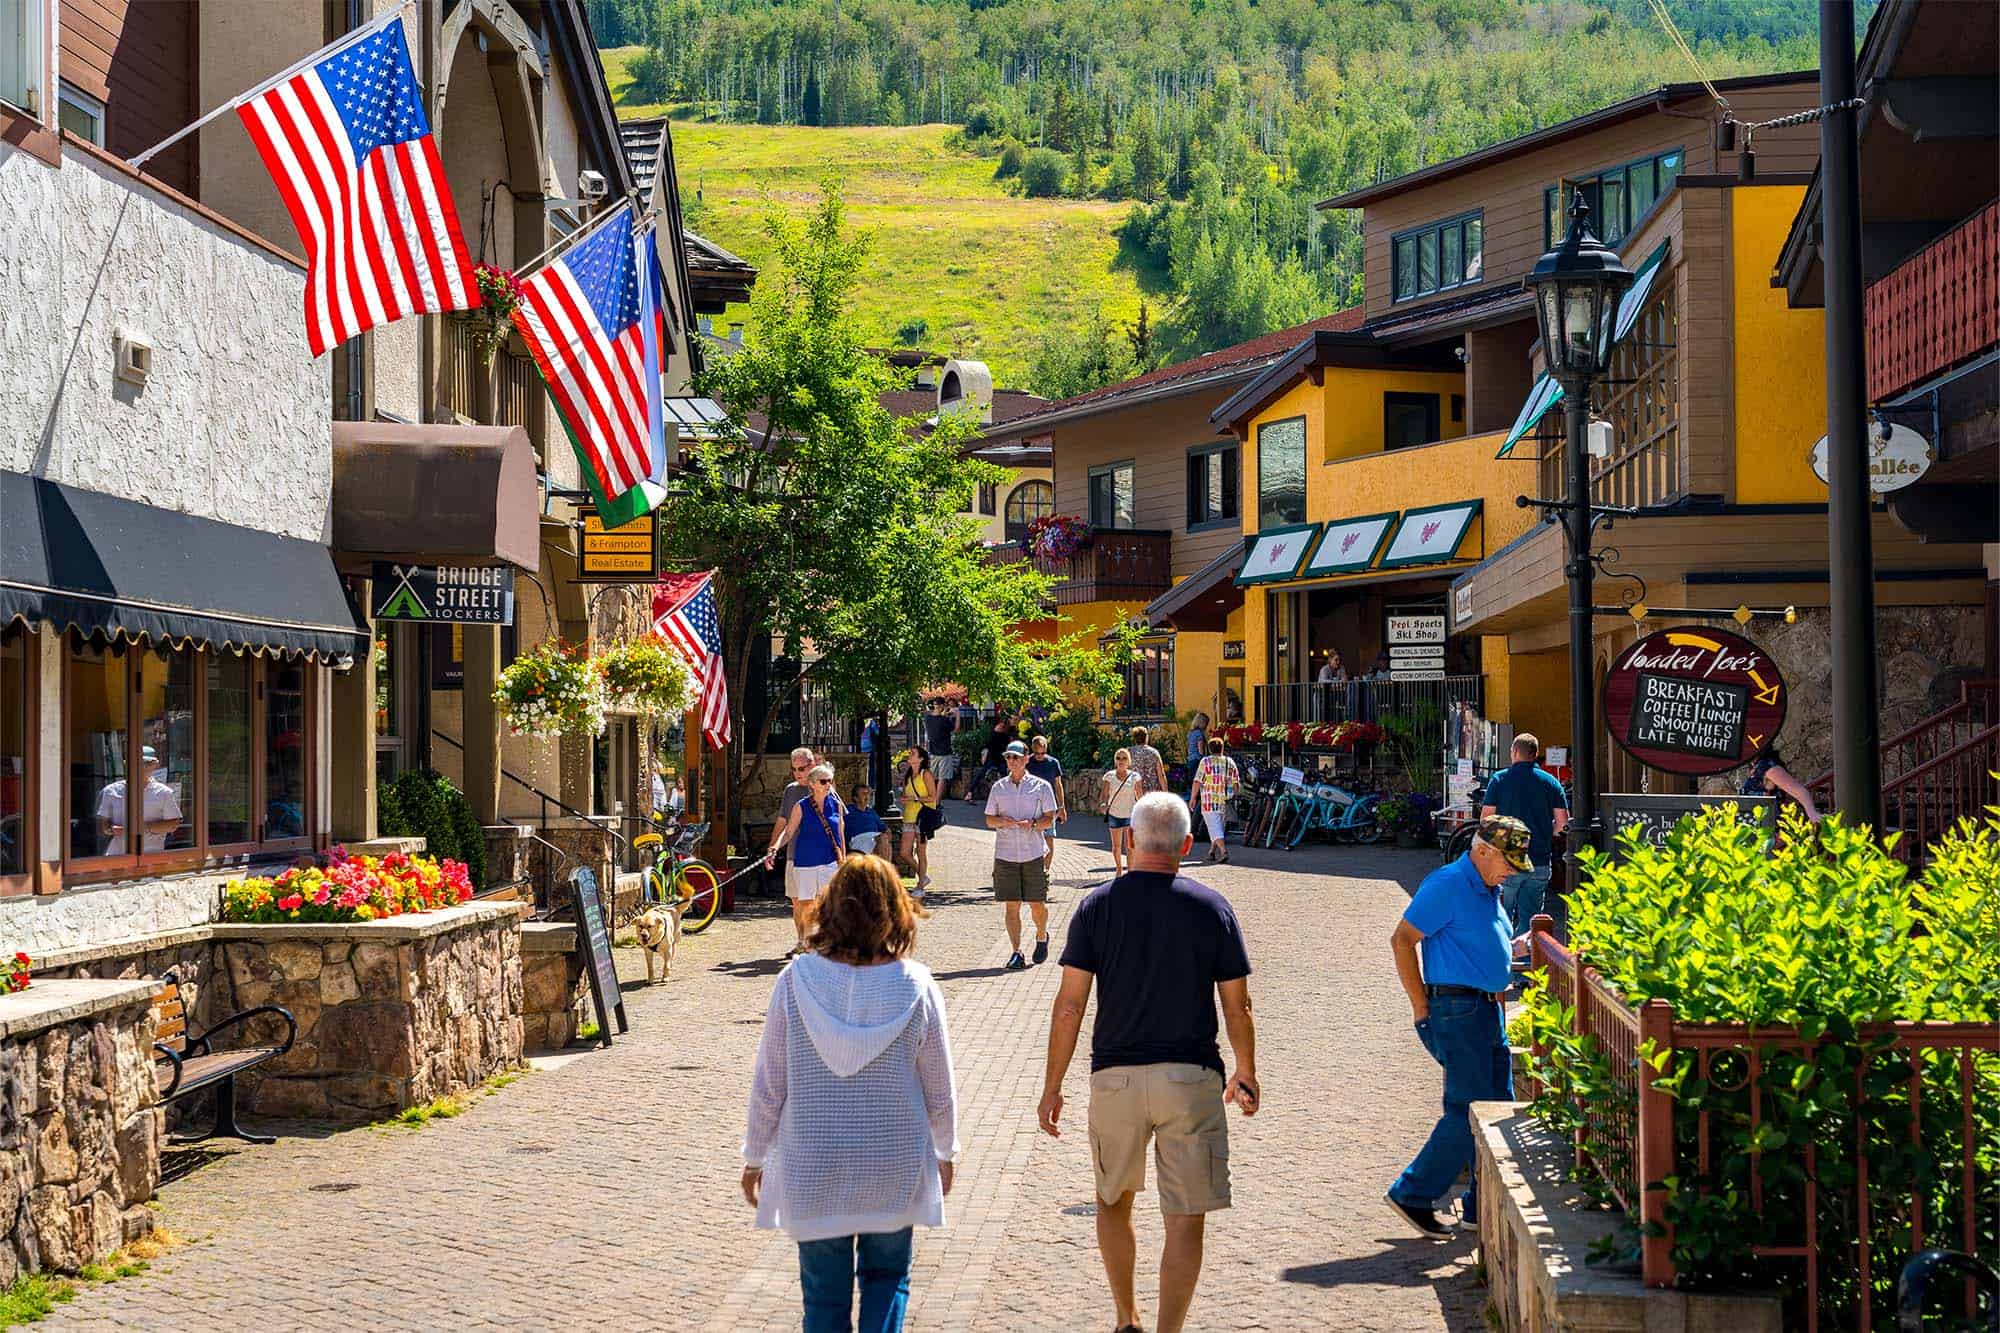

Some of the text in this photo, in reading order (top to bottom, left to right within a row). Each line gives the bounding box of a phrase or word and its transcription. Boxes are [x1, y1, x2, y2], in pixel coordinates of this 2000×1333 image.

[590, 539, 647, 550] & Frampton
[591, 558, 645, 568] Real Estate
[436, 566, 502, 586] BRIDGE
[435, 587, 502, 608] STREET
[435, 608, 501, 620] LOCKERS
[1413, 619, 1443, 629] Sports
[1395, 630, 1438, 640] Ski Shop
[1703, 646, 1761, 678] Joe's
[1647, 678, 1737, 709] BREAKFAST
[1643, 698, 1742, 725] COFFEE LUNCH
[1652, 714, 1734, 740] SMOOTHIES
[1638, 727, 1730, 752] LATE NIGHT
